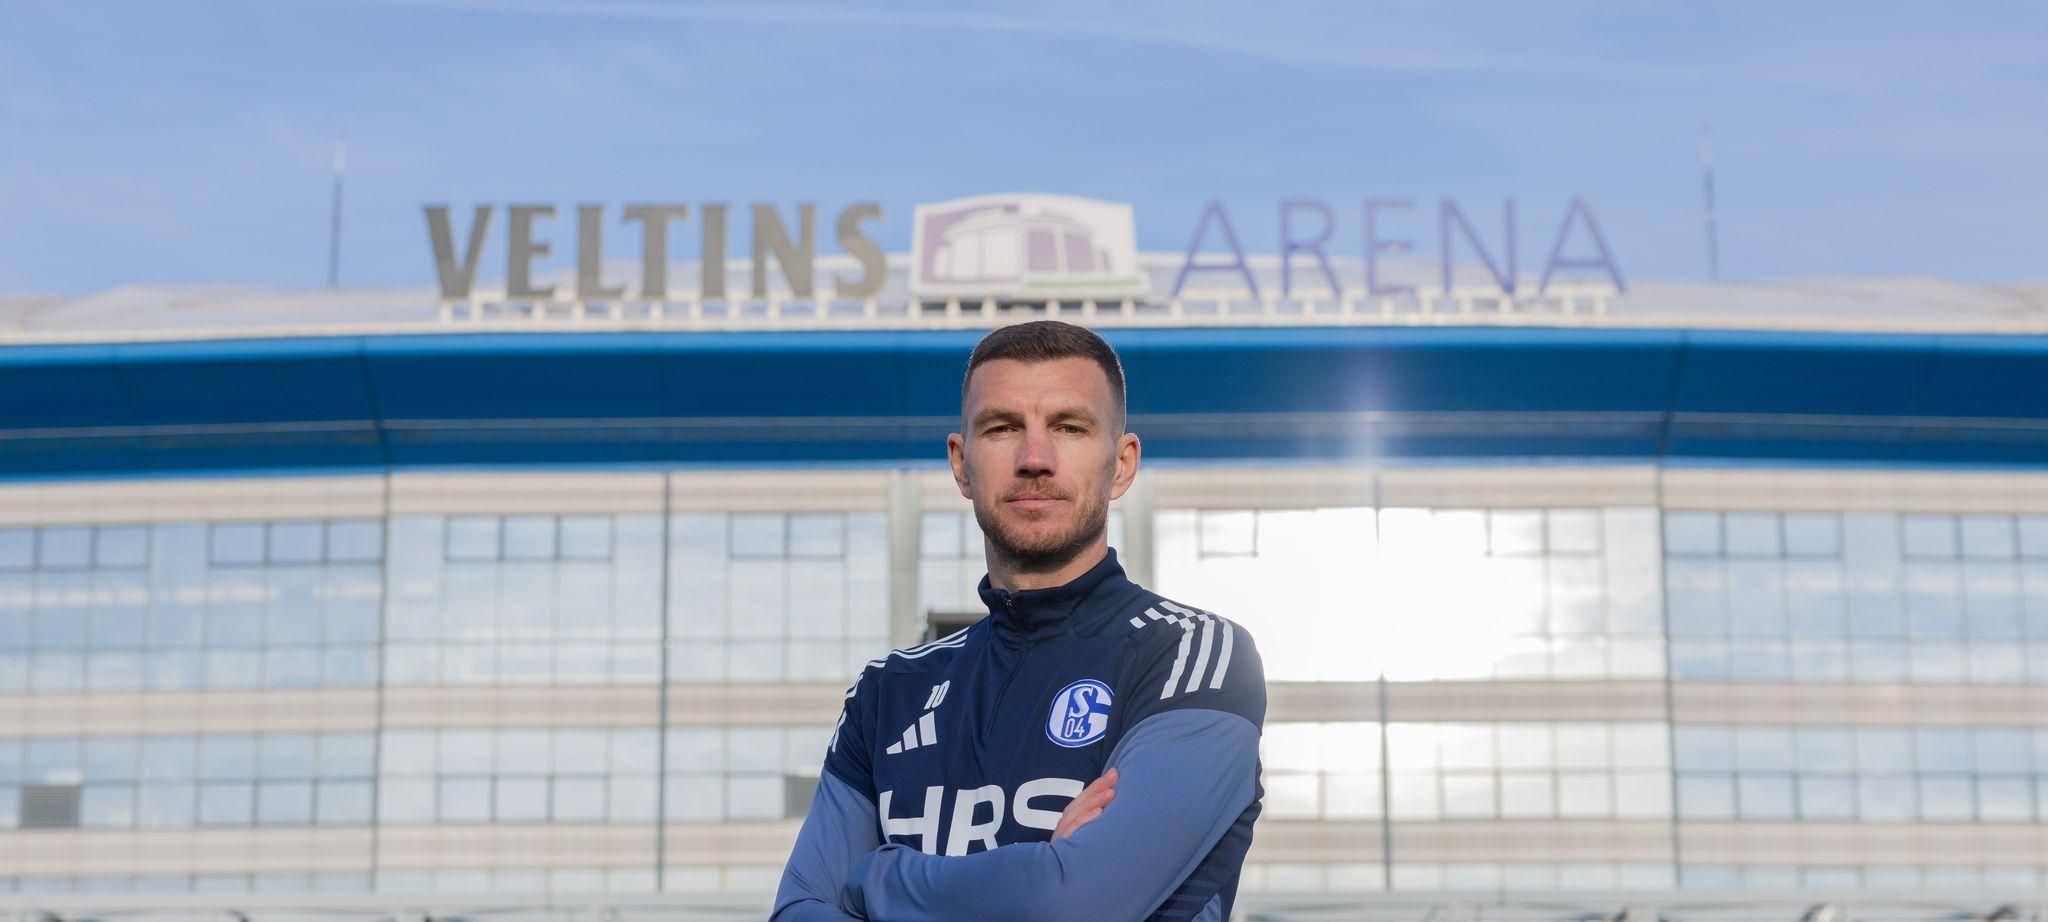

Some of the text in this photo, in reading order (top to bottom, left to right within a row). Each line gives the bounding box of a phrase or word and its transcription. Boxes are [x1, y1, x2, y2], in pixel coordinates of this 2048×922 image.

[423, 196, 1627, 299] VELTINS ARENA
[924, 680, 950, 709] 10
[1064, 717, 1085, 738] 04
[879, 778, 1085, 857] HRS
